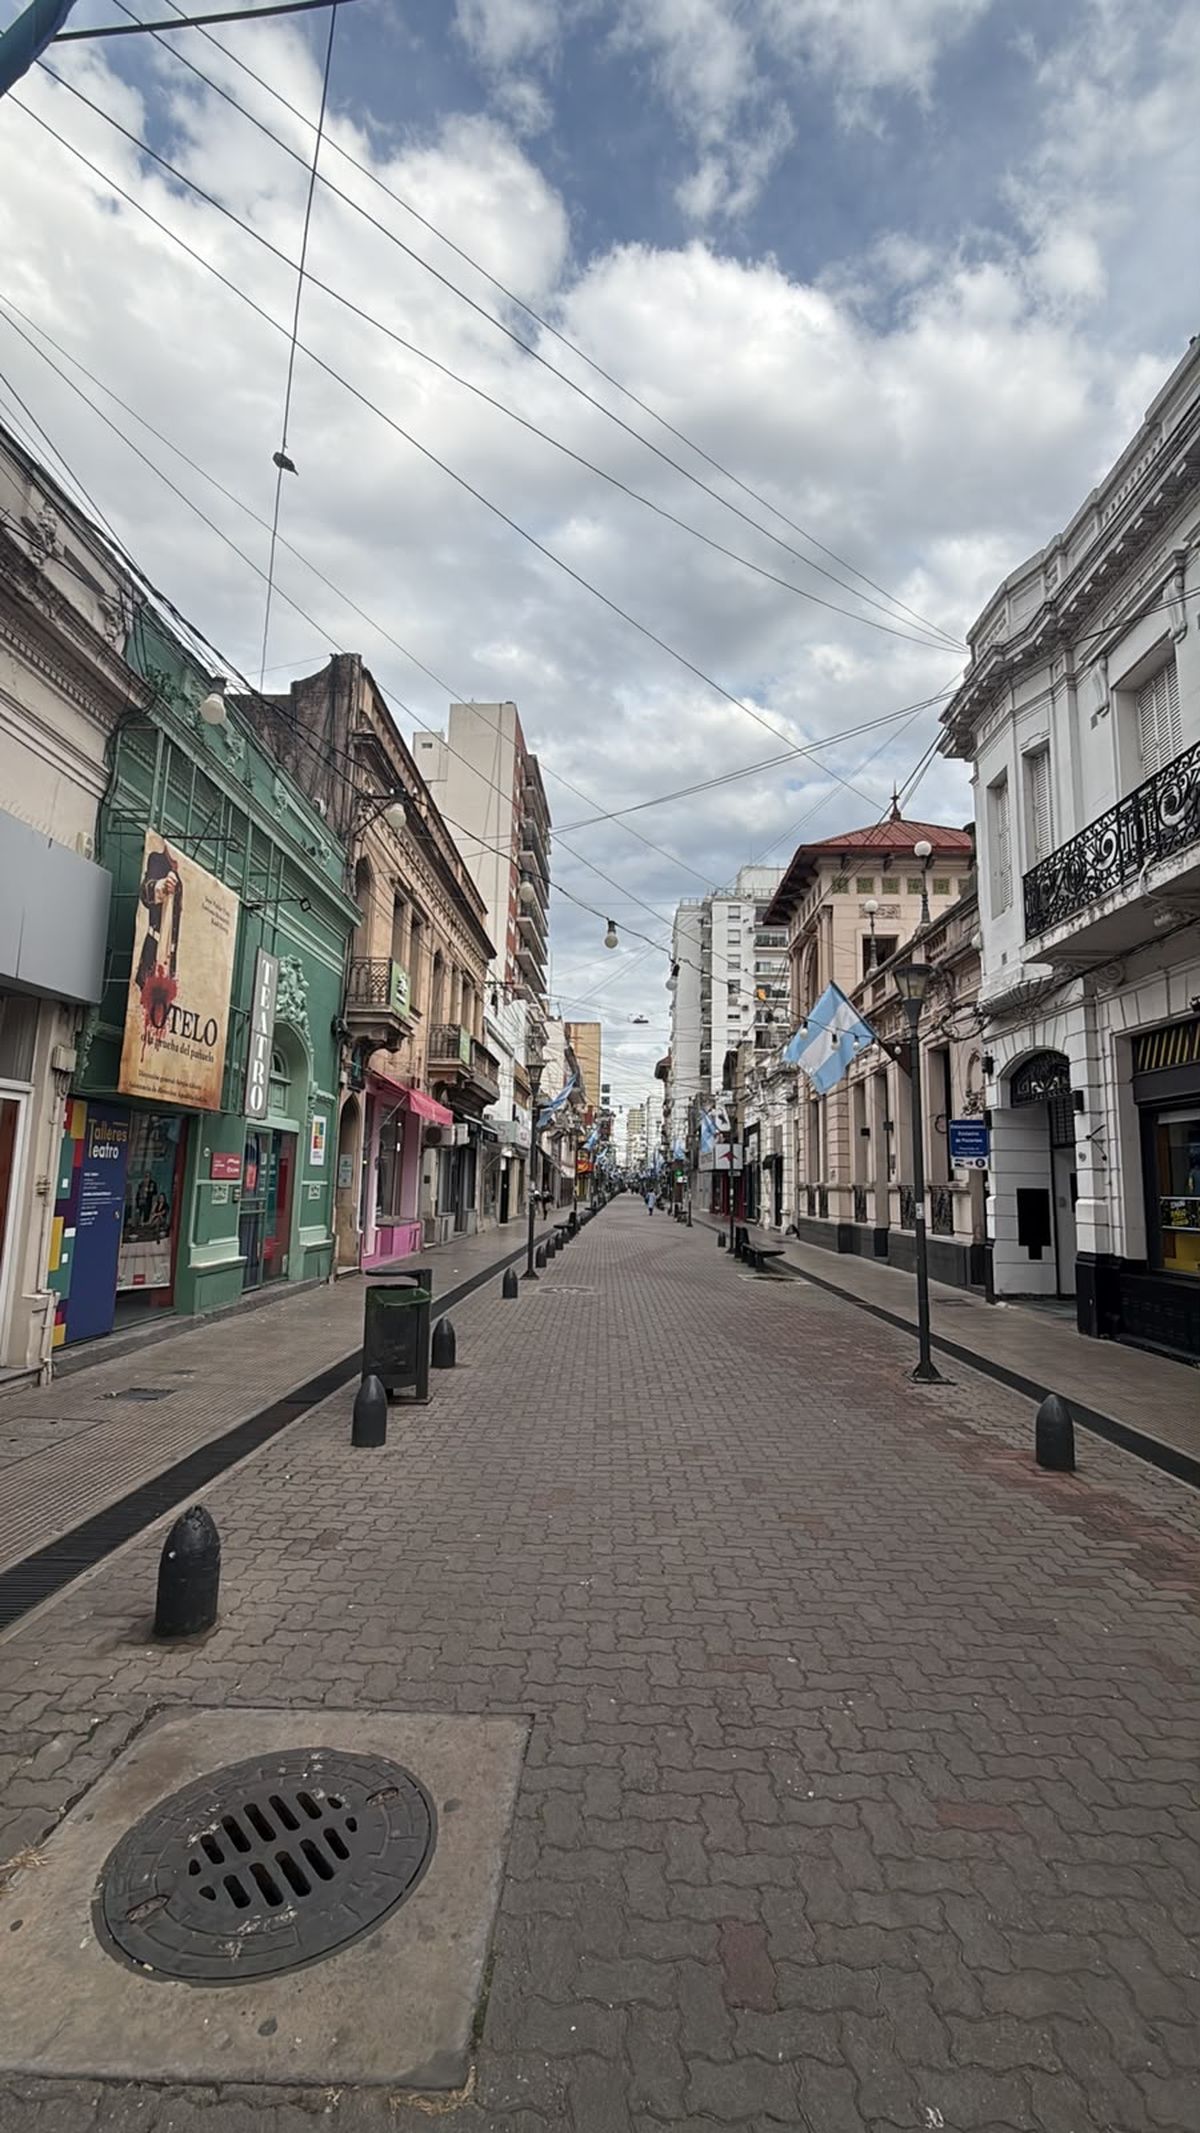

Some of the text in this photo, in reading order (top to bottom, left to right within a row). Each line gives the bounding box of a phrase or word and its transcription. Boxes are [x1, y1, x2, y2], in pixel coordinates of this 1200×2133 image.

[150, 1001, 218, 1047] OTELO
[250, 959, 273, 1111] TEATRO
[88, 1119, 128, 1142] Talleres
